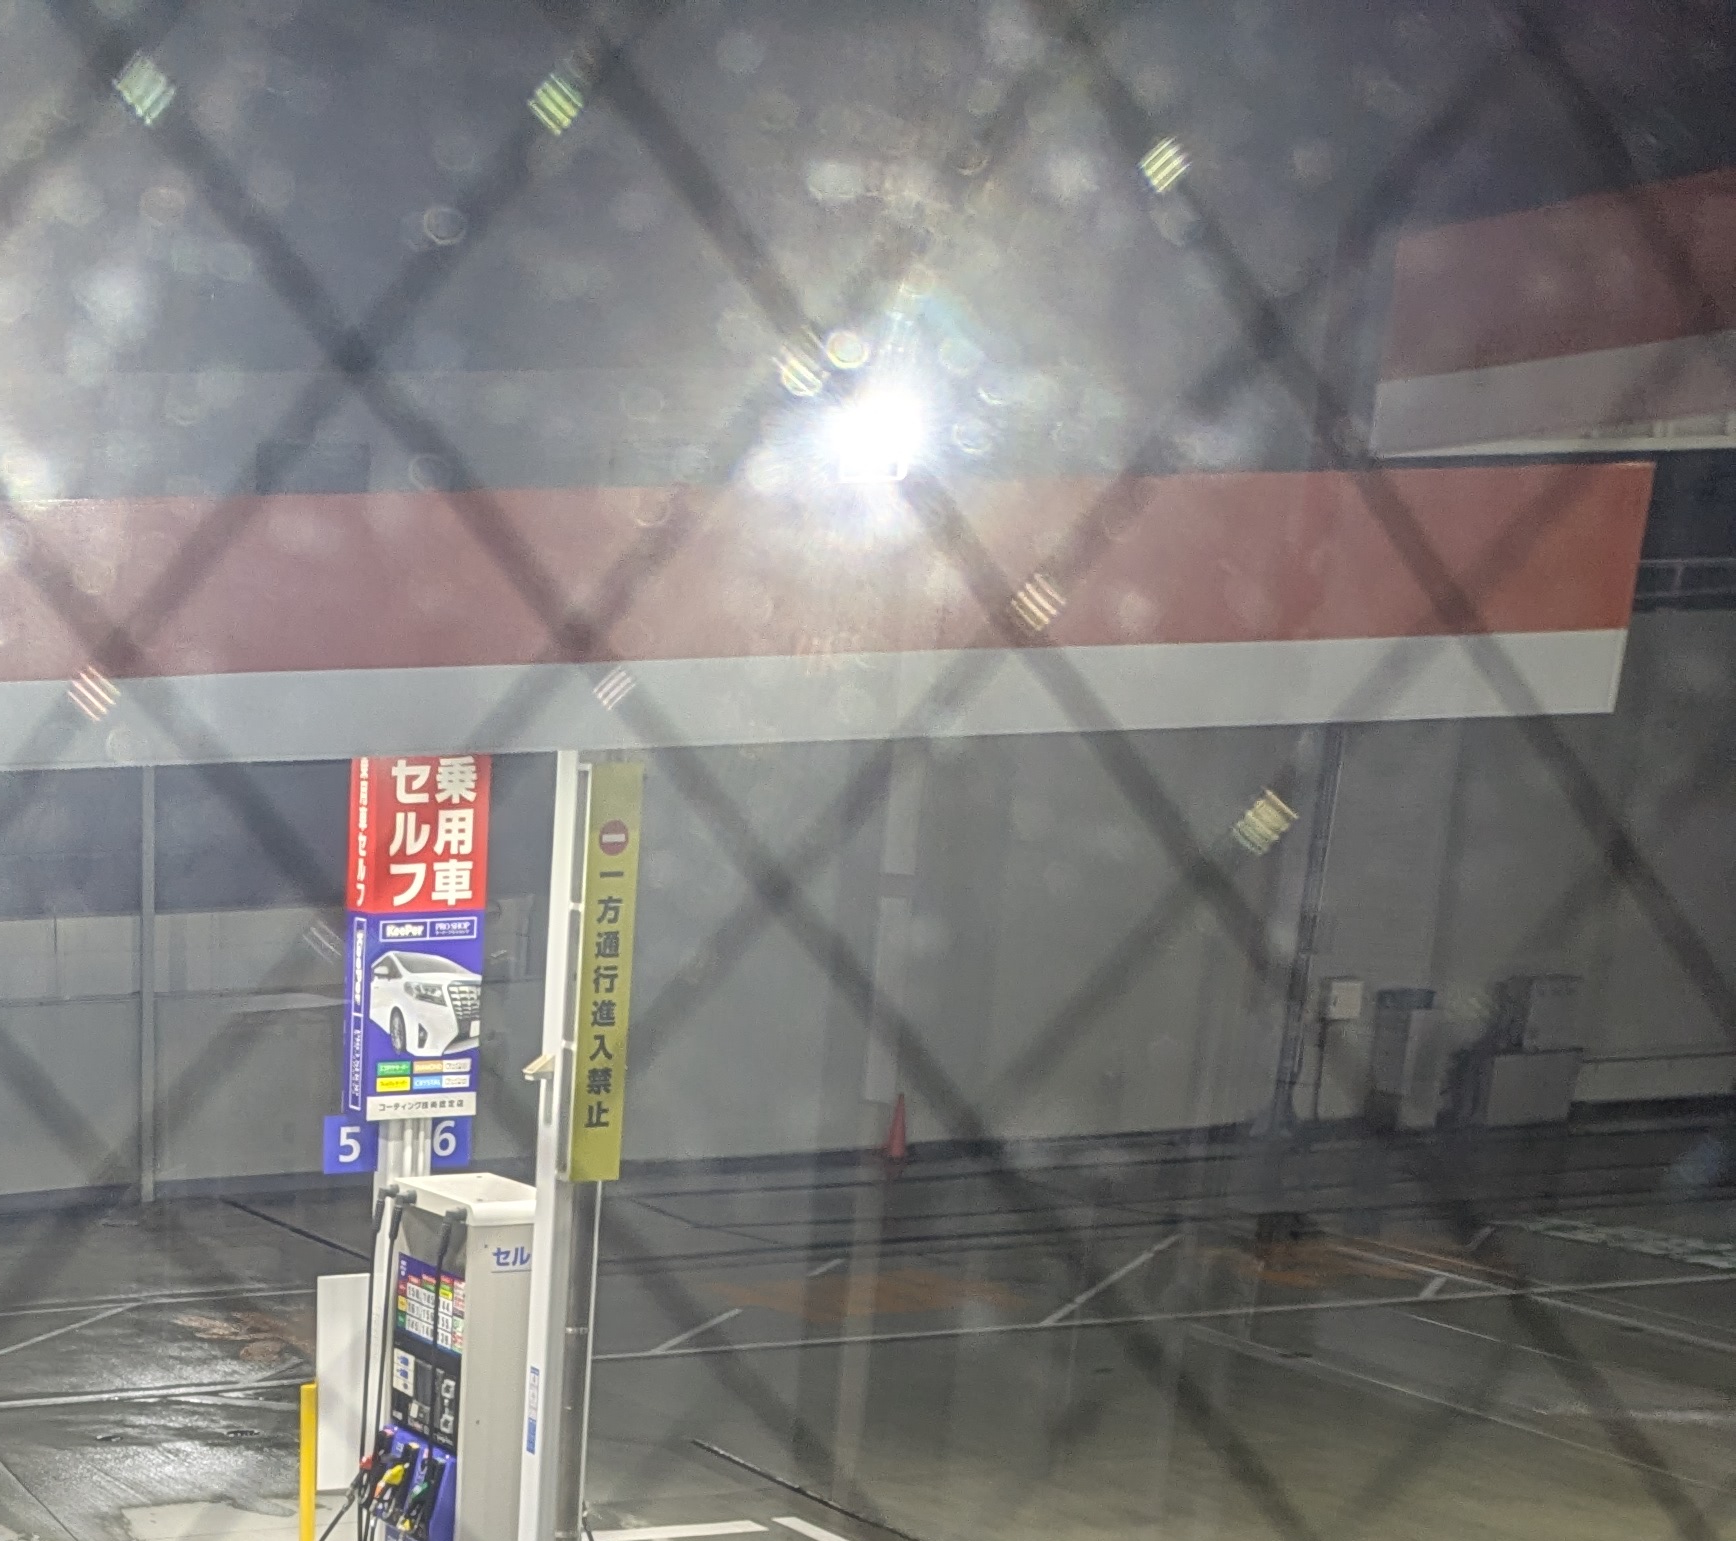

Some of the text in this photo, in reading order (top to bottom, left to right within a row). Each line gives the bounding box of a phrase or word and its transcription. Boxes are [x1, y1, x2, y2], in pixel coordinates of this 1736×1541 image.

[389, 759, 431, 907] セルフ
[431, 755, 478, 906] 乗用車
[386, 924, 424, 938] KeePer
[584, 870, 625, 1128] 一方通行進入禁止
[339, 1126, 361, 1163] 5
[433, 1120, 456, 1157] 6
[492, 1246, 531, 1267] セル
